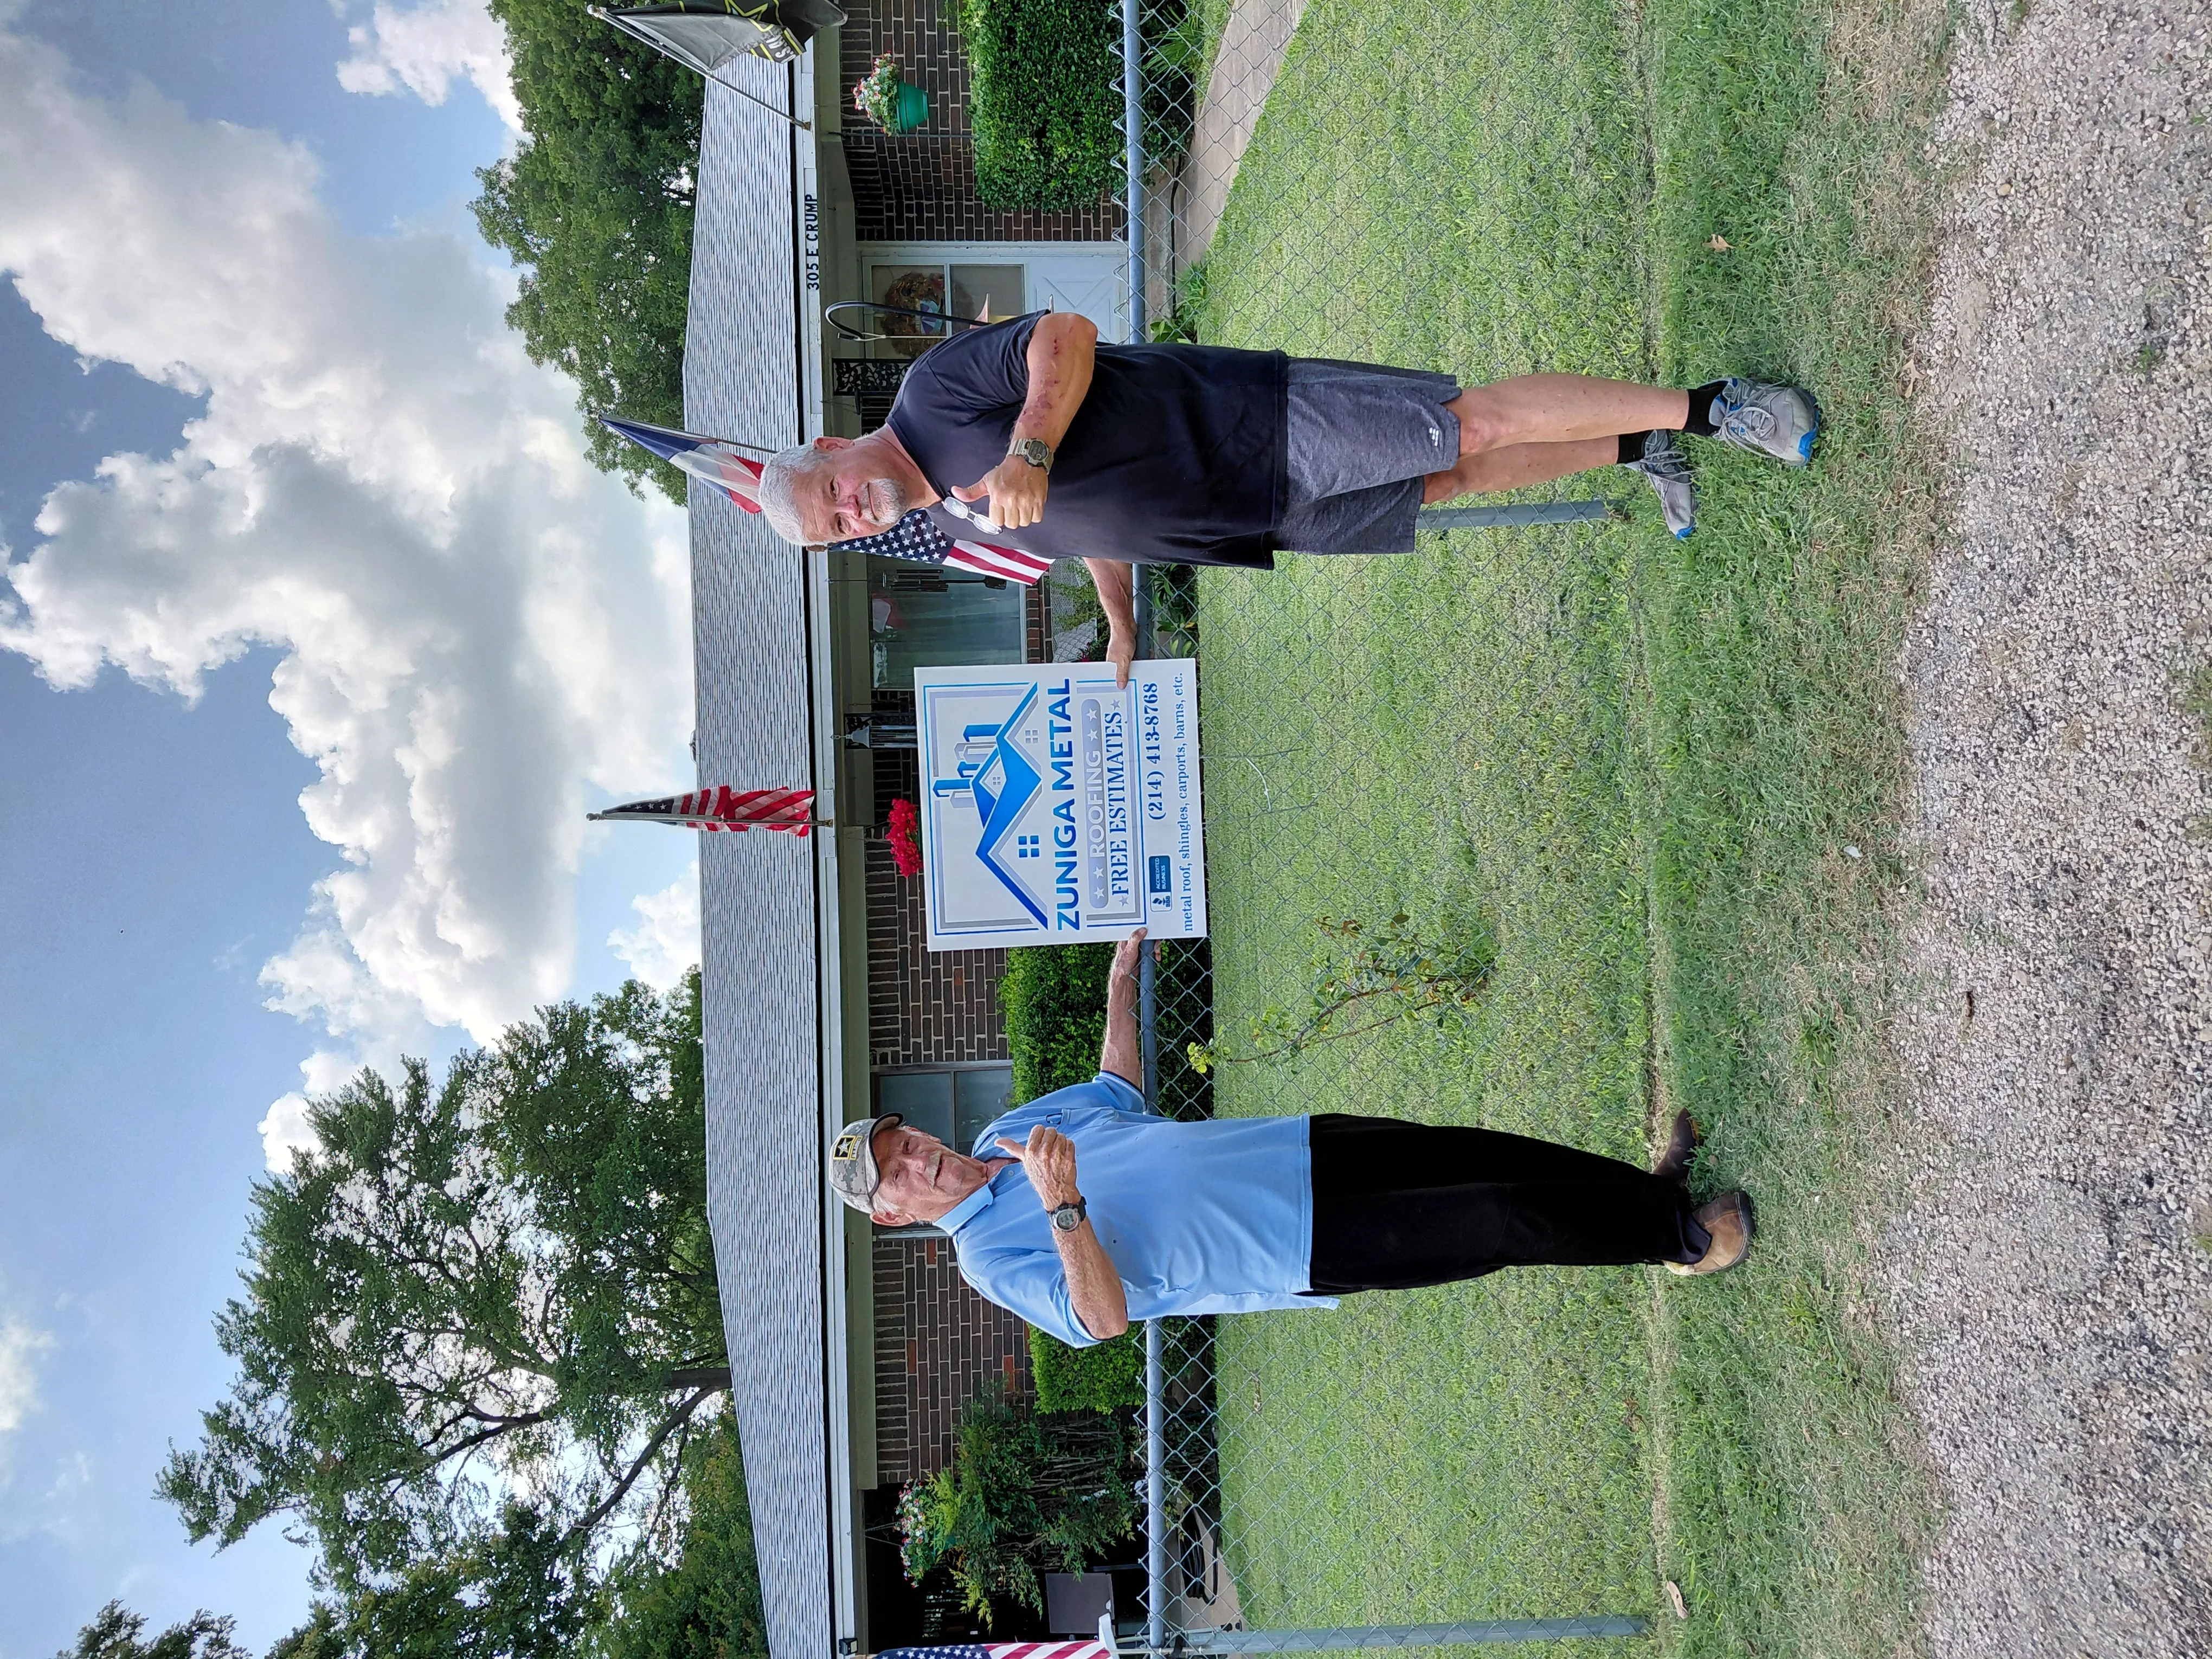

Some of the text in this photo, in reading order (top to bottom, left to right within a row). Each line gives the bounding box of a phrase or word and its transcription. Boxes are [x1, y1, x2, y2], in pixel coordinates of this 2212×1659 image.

[805, 195, 819, 291] 305 E CRUMP
[1047, 678, 1080, 930] ZUNIGA METAL
[1085, 751, 1105, 858] ROOFING
[1104, 712, 1129, 896] FREE ESTIMATES
[1143, 683, 1166, 820] (214) 413-8768
[1172, 673, 1193, 931] metal roof, shingles, carports, barns, etc.
